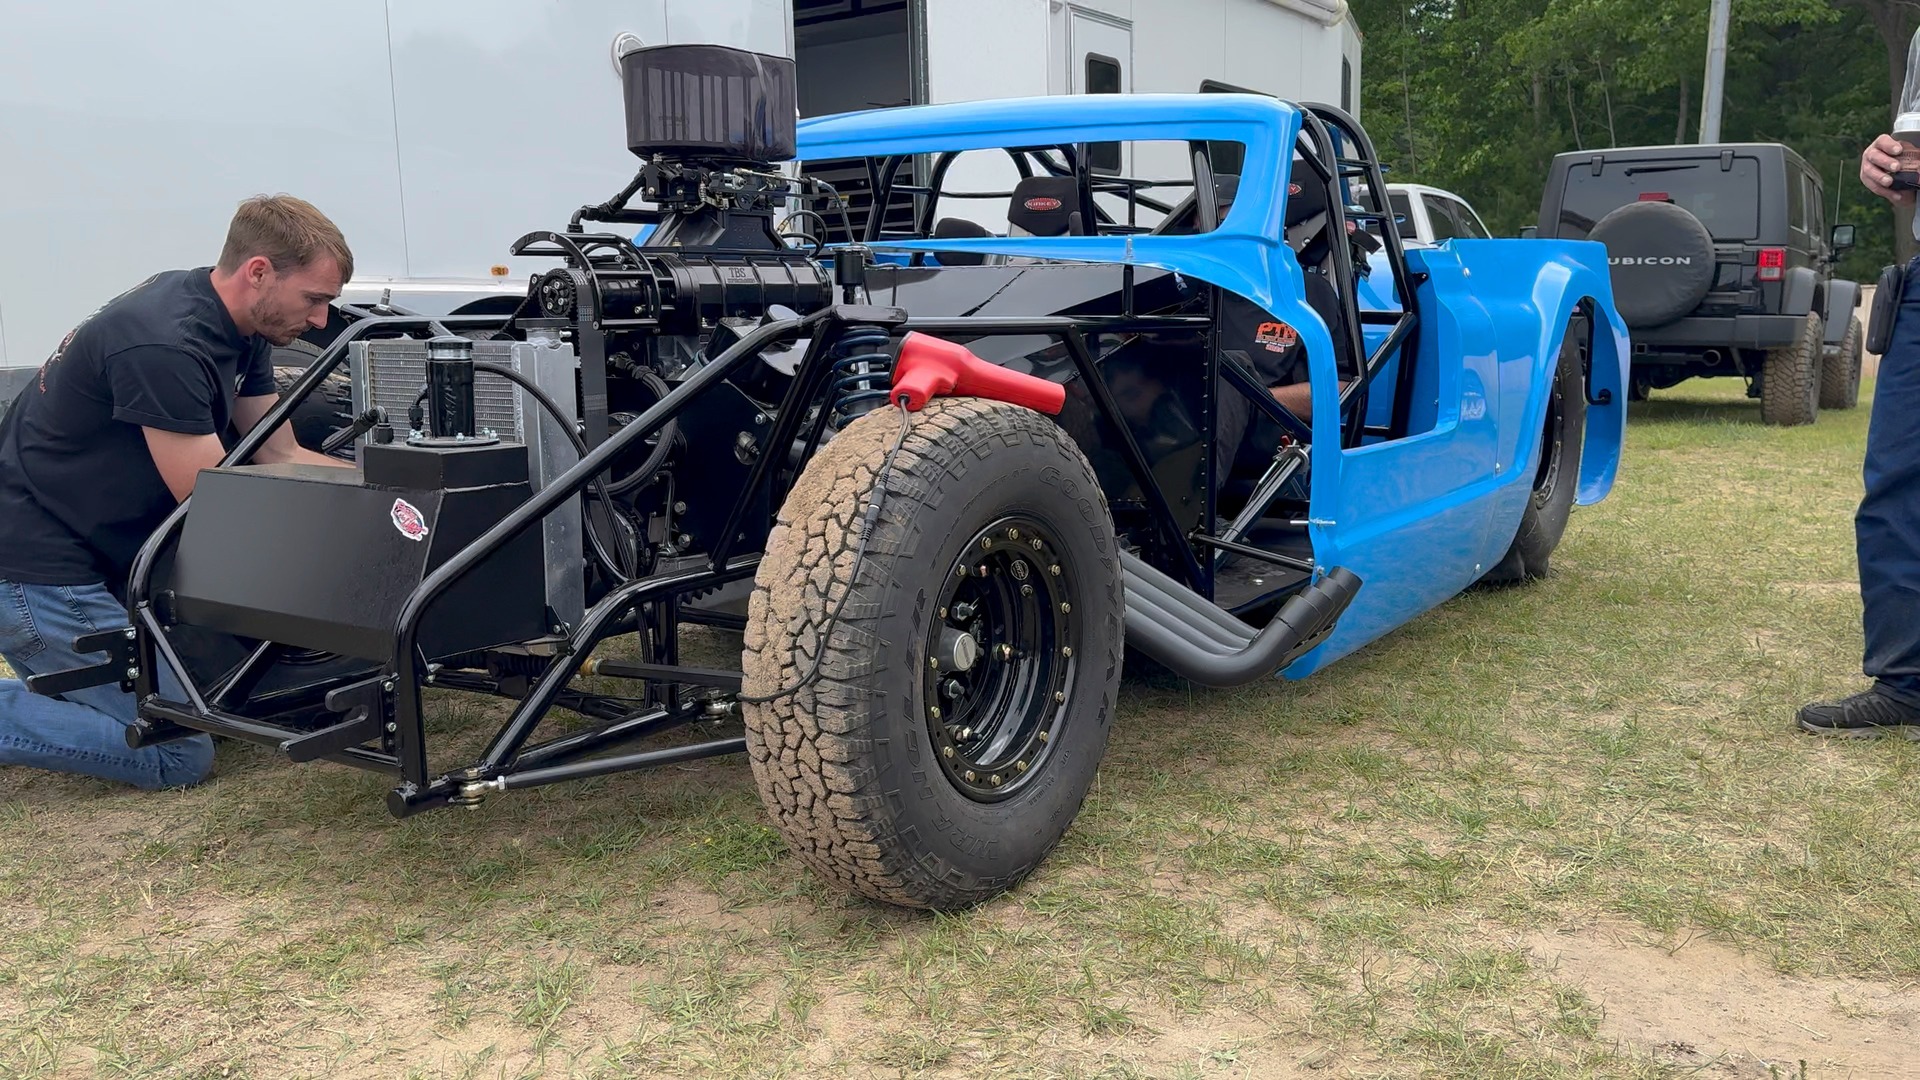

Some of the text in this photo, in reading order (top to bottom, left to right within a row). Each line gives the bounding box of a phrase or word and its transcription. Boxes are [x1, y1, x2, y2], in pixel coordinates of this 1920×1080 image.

[728, 267, 747, 278] TBS
[1607, 256, 1691, 265] UBICON
[1038, 466, 1119, 728] GOODYEAR
[903, 588, 1000, 859] WRANGLER
